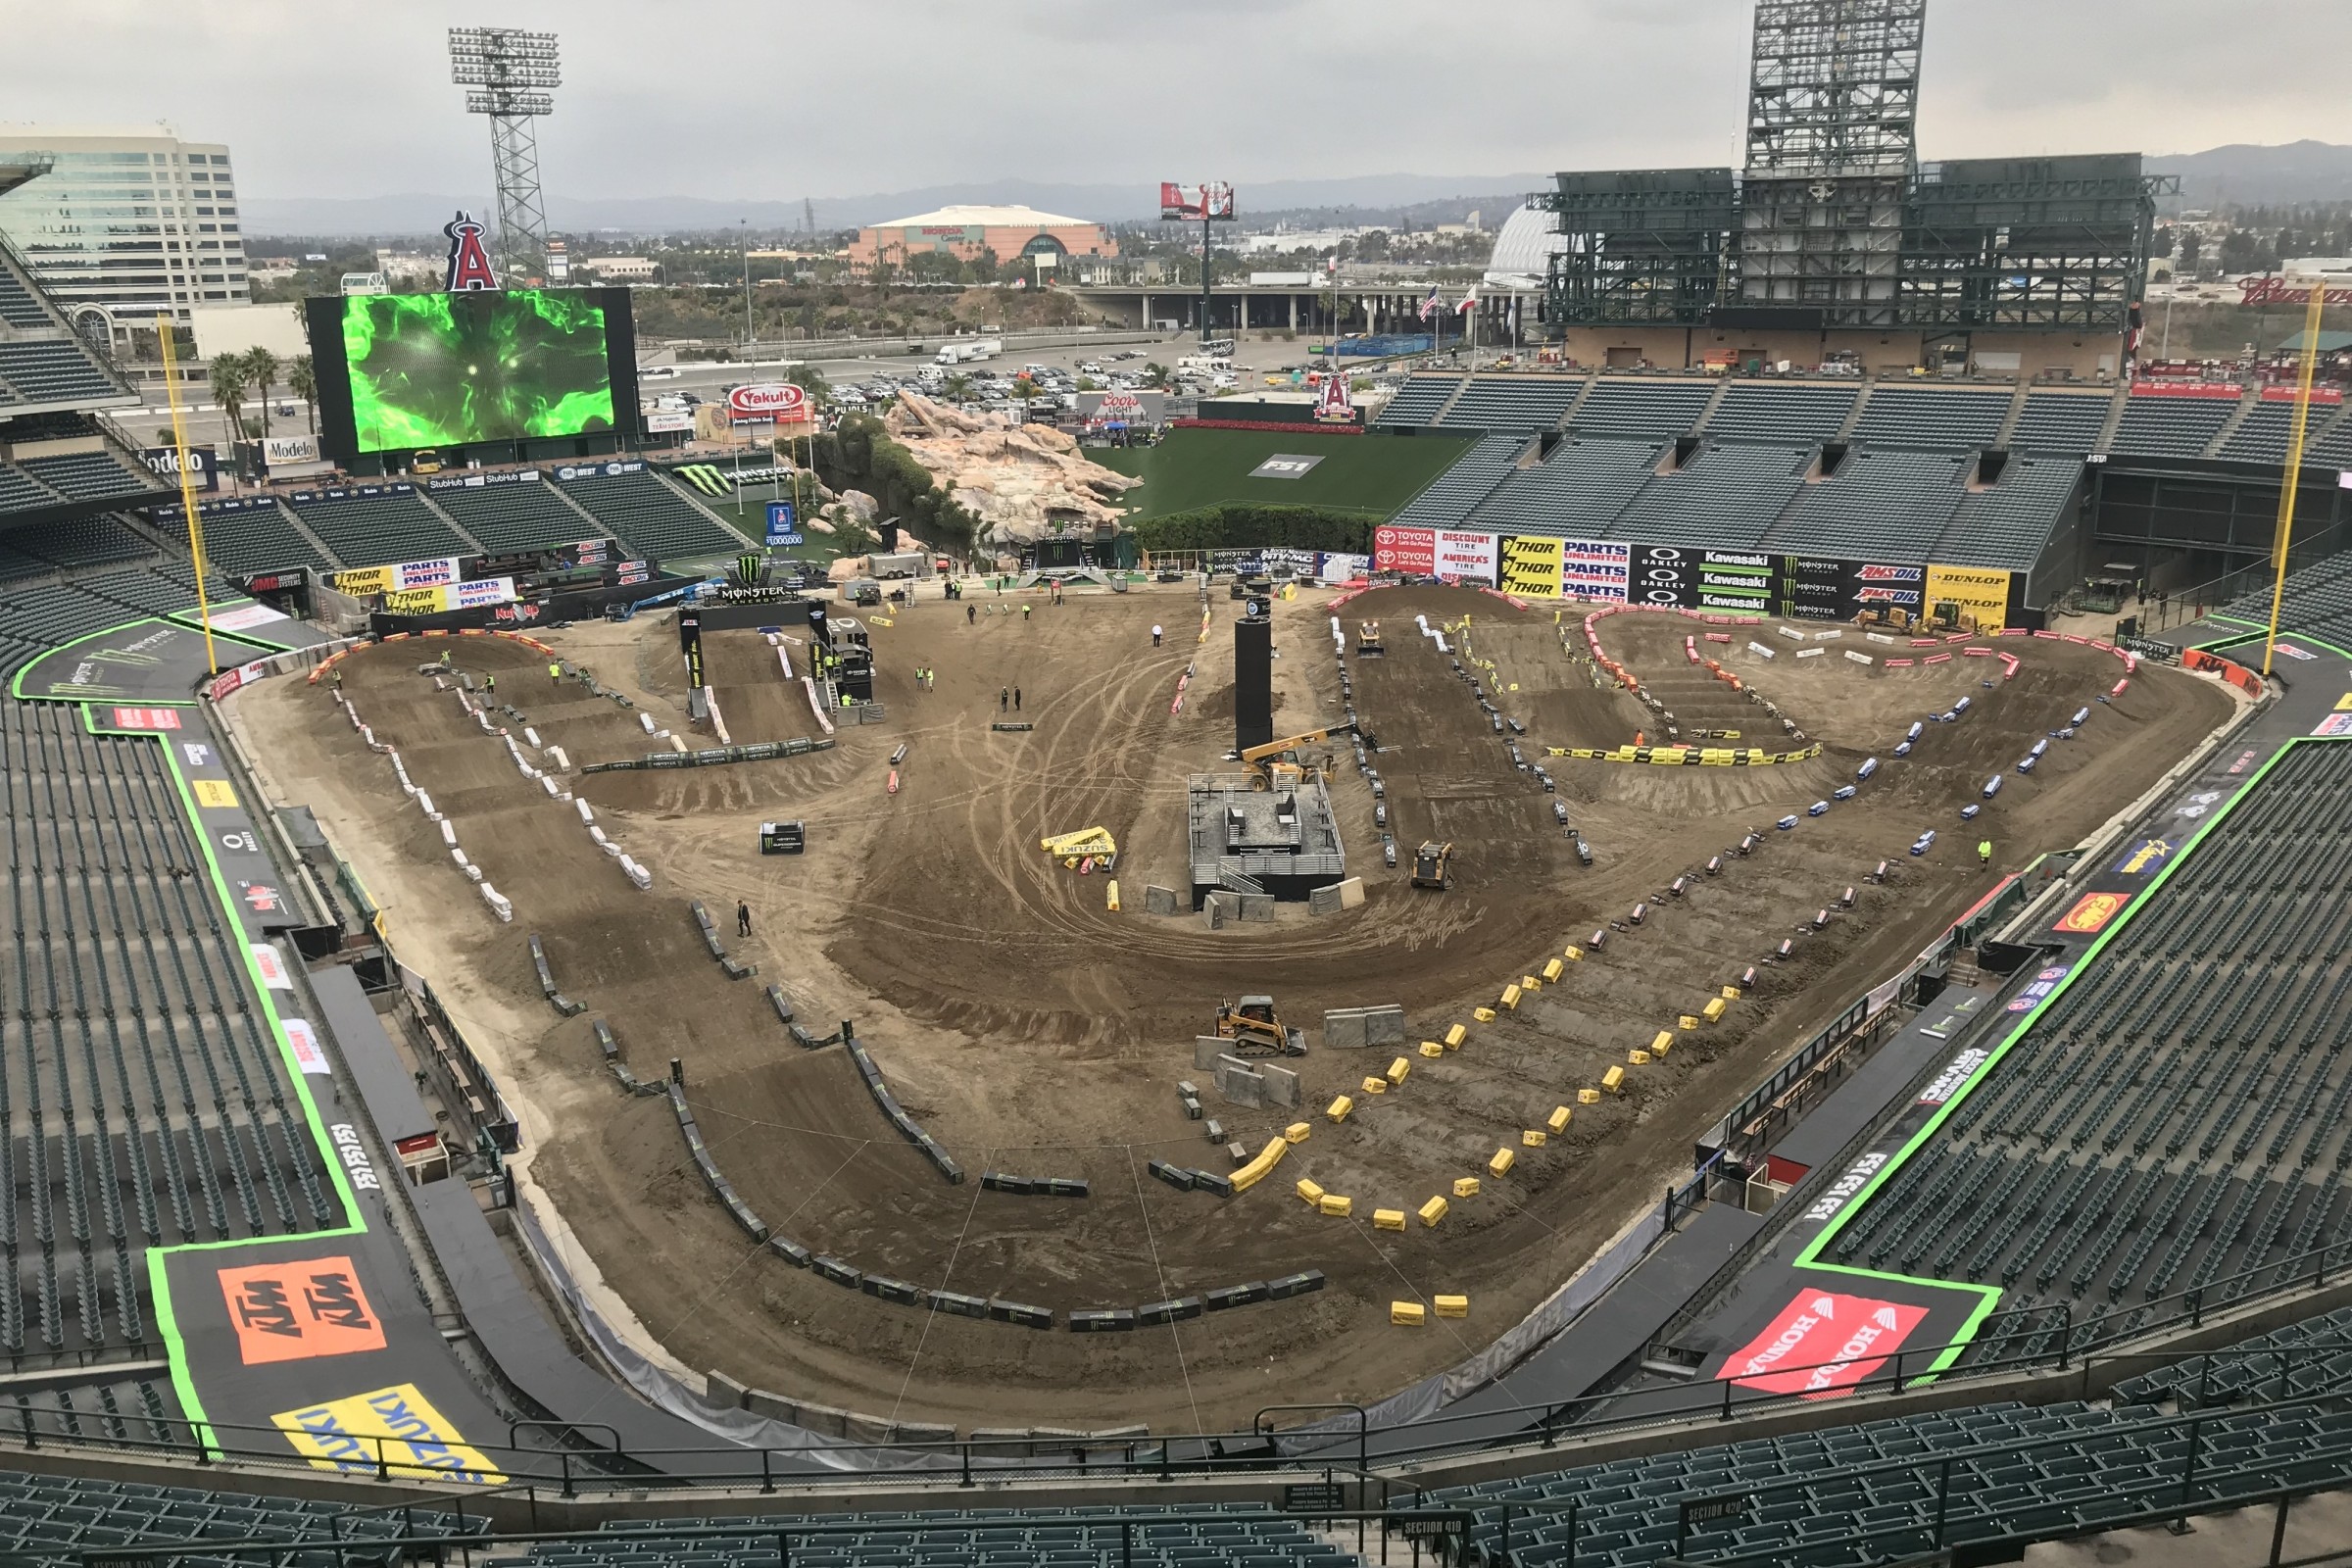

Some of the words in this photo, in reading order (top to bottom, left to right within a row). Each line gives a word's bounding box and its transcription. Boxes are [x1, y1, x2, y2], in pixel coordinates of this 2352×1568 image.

[744, 391, 794, 405] Yakult
[1102, 392, 1139, 406] Coors
[834, 405, 868, 415] PUJOLS
[271, 440, 313, 458] Modelo
[577, 467, 596, 476] WEST
[623, 464, 642, 472] WEST
[1262, 461, 1309, 471] FS1
[430, 479, 463, 489] StubHub
[486, 474, 518, 483] StubHub
[1396, 532, 1433, 542] TOYOTA
[1443, 533, 1490, 544] DISCOUNT
[576, 541, 606, 552] AMSOIL
[1515, 542, 1556, 554] THOR
[1564, 542, 1628, 556] PARTS
[578, 554, 608, 564] AMSOIL
[1396, 551, 1433, 562] TOYOTA
[1442, 554, 1489, 564] AMERICA'S
[1564, 552, 1628, 563] UNLIMITED
[1705, 552, 1768, 566] Kawasaki
[402, 560, 449, 572] PARTS
[616, 561, 647, 572] AMSOIL
[1514, 563, 1555, 574] THOR
[1563, 563, 1627, 576] PARTS
[1642, 560, 1688, 568] OAKLEY
[1797, 561, 1838, 571] MONSTER
[278, 573, 301, 582] SECURITY
[346, 570, 380, 582] THOR
[402, 567, 450, 576] UNLIMITED
[1563, 572, 1627, 583] UNLIMITED
[1854, 564, 1922, 582] AMSOIL
[252, 577, 278, 591] JMG
[278, 579, 301, 588] SYSTEMS
[404, 572, 451, 584] PARTS
[618, 573, 649, 585] AMSOIL
[1704, 573, 1767, 588] Kawasaki
[1941, 573, 2006, 585] DUNLOP
[348, 583, 383, 596] THOR
[458, 580, 499, 593] PARTS
[1513, 582, 1553, 595] THOR
[1562, 583, 1626, 597] PARTS
[1641, 580, 1686, 589] OAKLEY
[1796, 582, 1838, 593] MONSTER
[398, 590, 433, 603] THOR
[722, 586, 785, 599] MONSTER
[1852, 586, 1920, 605] AMSOIL
[1702, 594, 1765, 610] Kawasaki
[1794, 604, 1836, 614] MONSTER
[2127, 638, 2170, 655] MONSTER
[1061, 844, 1108, 853] SUZUKI
[330, 1123, 360, 1145] FS1
[340, 1145, 369, 1167] FS1
[1849, 1152, 1887, 1175] FS1
[350, 1167, 380, 1190] FS1
[1827, 1175, 1866, 1197] FS1
[1803, 1197, 1843, 1220] FS1
[304, 1272, 371, 1331] KTM
[235, 1280, 303, 1339] KTM
[1738, 1314, 1820, 1381] HONDA
[1805, 1325, 1883, 1391] HONDA
[1689, 1503, 1724, 1522] SECTION
[1726, 1501, 1741, 1514] 420
[1404, 1521, 1443, 1534] SECTION
[1446, 1520, 1462, 1533] 419
